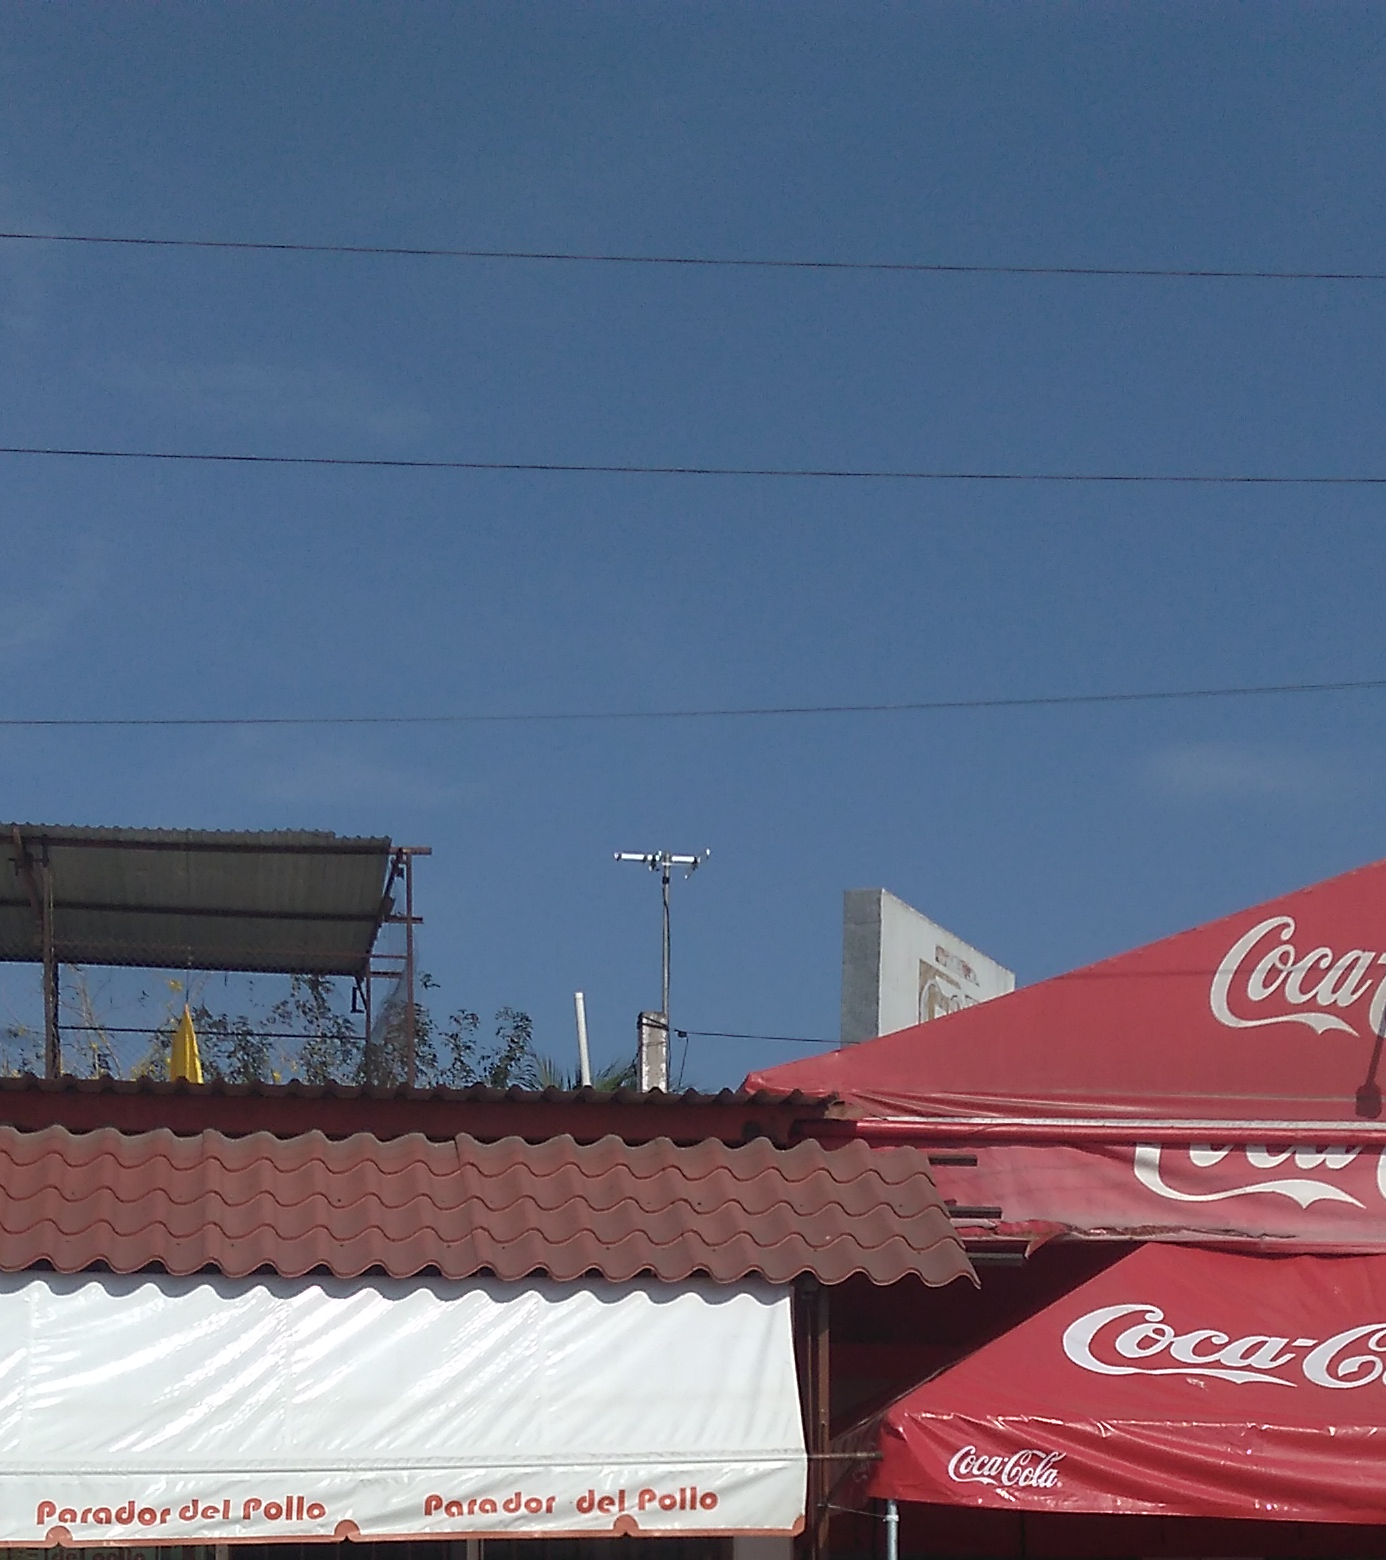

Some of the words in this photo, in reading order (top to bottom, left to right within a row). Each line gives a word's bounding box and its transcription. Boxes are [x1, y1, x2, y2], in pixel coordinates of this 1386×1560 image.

[947, 1445, 1067, 1488] Coca-Cola
[36, 1500, 171, 1527] Parador
[178, 1498, 231, 1522] del
[242, 1495, 327, 1521] Pollo
[423, 1491, 557, 1518] Parador
[575, 1489, 626, 1515] del
[637, 1486, 719, 1512] Pollo
